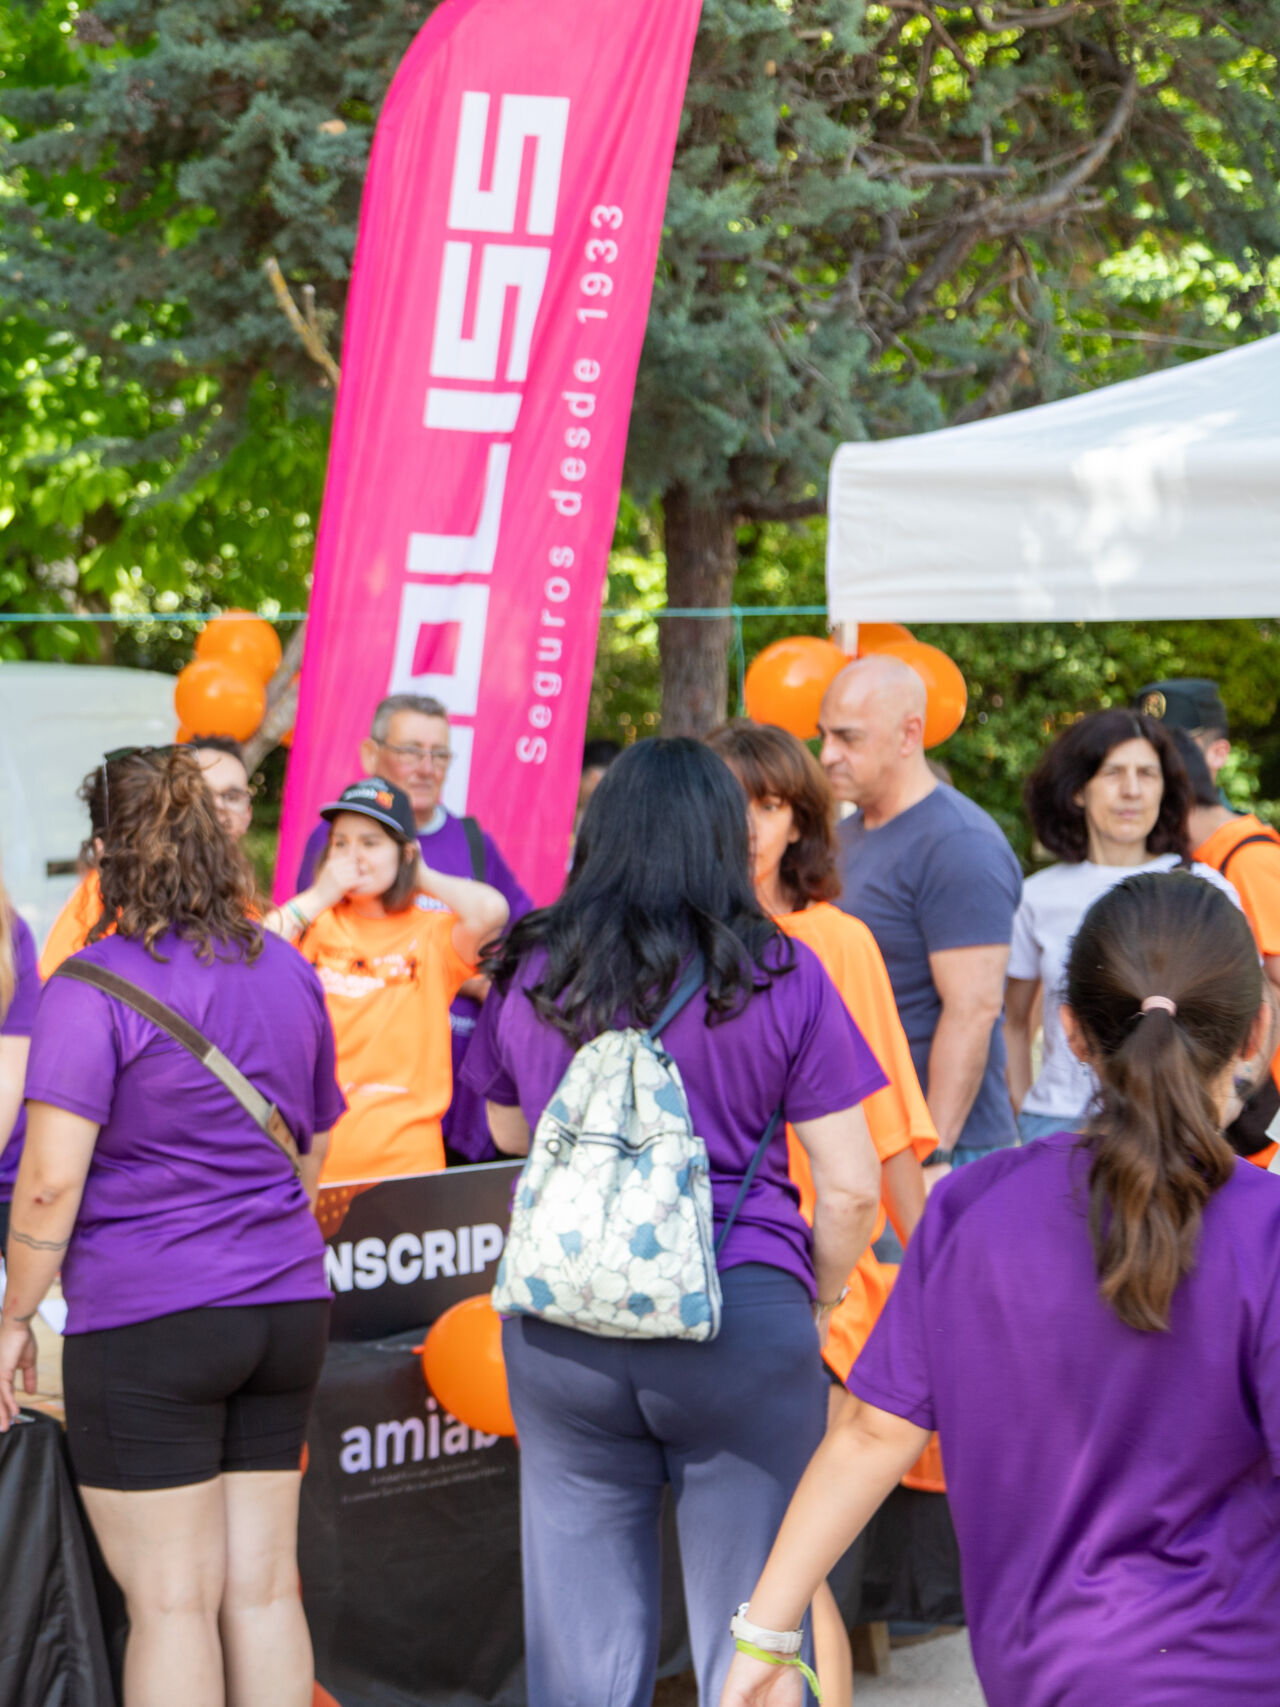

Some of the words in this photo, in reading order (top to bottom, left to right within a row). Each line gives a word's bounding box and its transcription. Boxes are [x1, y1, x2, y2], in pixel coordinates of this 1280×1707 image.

[515, 545, 575, 765] Seguros
[549, 357, 602, 517] desde
[576, 204, 624, 324] 1933
